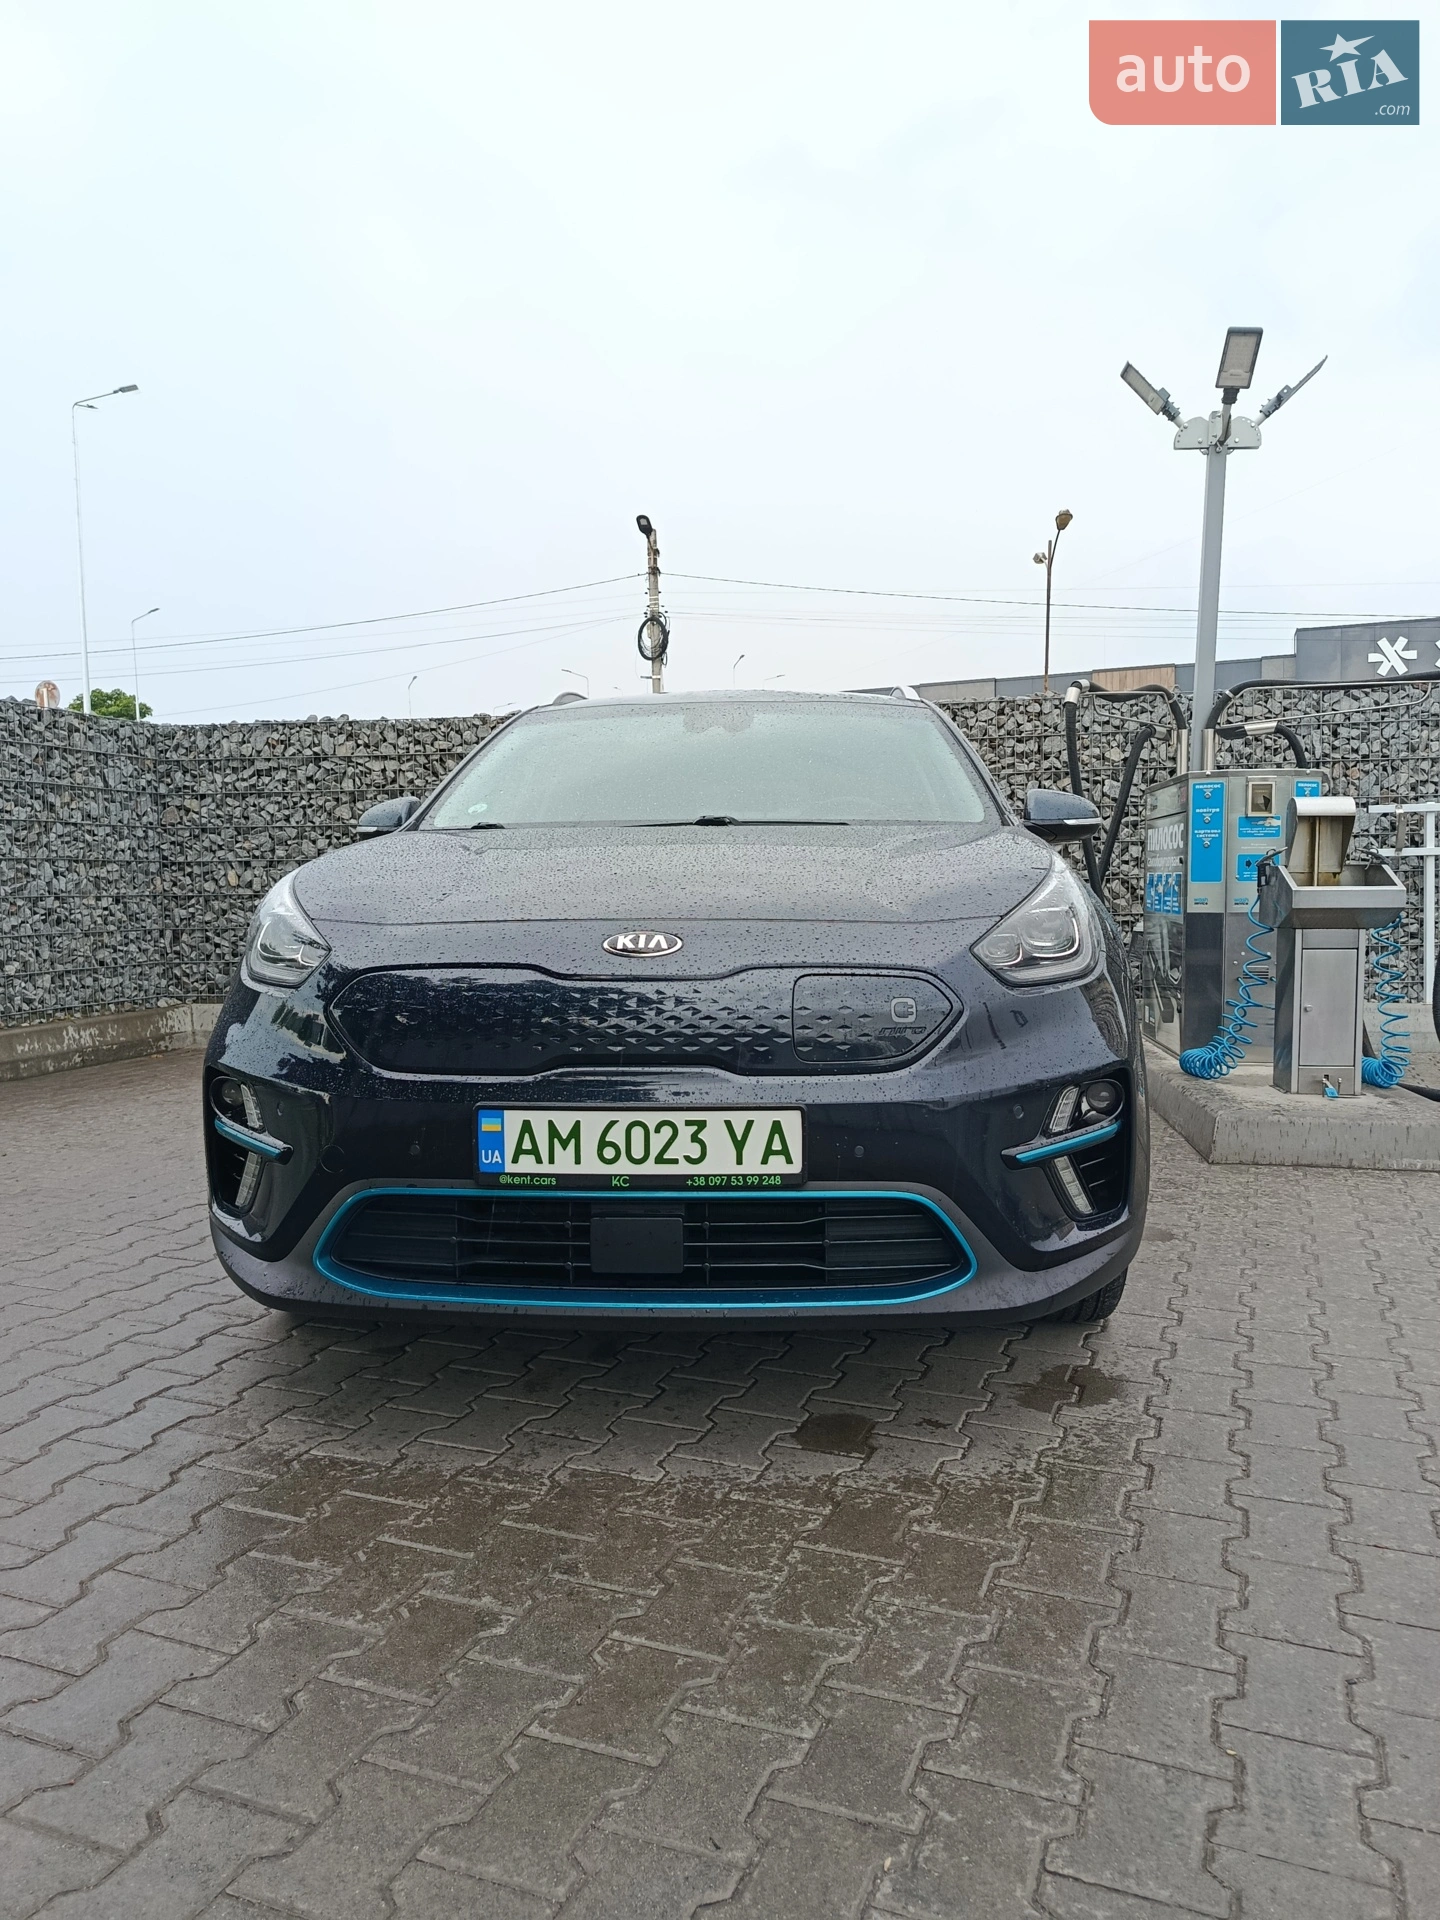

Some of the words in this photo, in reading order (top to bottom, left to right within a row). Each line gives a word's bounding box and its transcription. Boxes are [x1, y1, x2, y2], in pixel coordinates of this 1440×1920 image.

[616, 934, 669, 950] KIA
[511, 1119, 581, 1165] AM
[596, 1119, 708, 1165] 6023
[723, 1119, 794, 1165] YA
[481, 1150, 502, 1164] UA
[499, 1175, 557, 1185] @kent.cars
[611, 1176, 630, 1187] KC
[686, 1176, 706, 1186] +38
[708, 1176, 728, 1186] 097
[730, 1175, 744, 1186] 53
[746, 1175, 759, 1185] 99
[762, 1175, 782, 1185] 248
